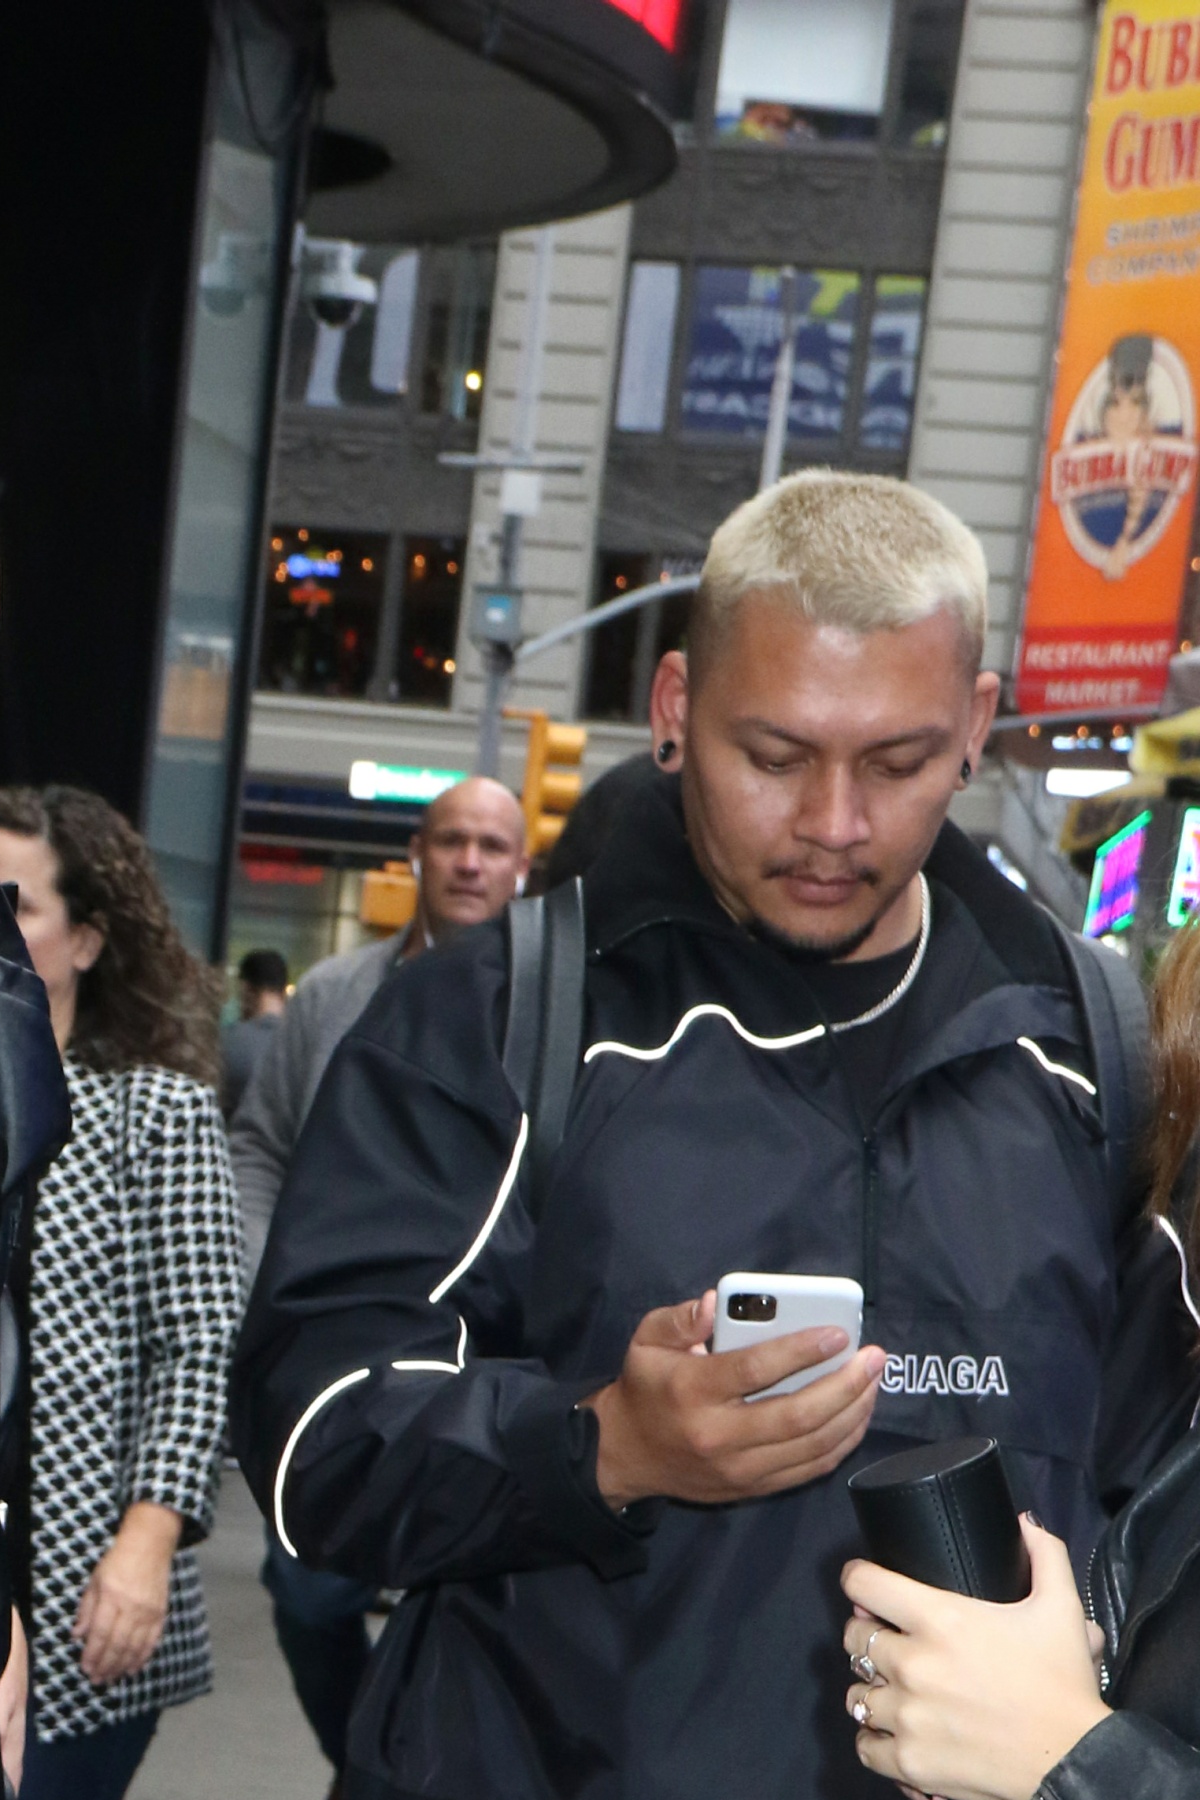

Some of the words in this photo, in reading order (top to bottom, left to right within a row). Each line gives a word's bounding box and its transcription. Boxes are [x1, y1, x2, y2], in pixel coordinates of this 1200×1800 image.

[1104, 14, 1200, 96] BUB
[1025, 640, 1170, 669] RESTAURANT
[1045, 678, 1141, 705] MARKET
